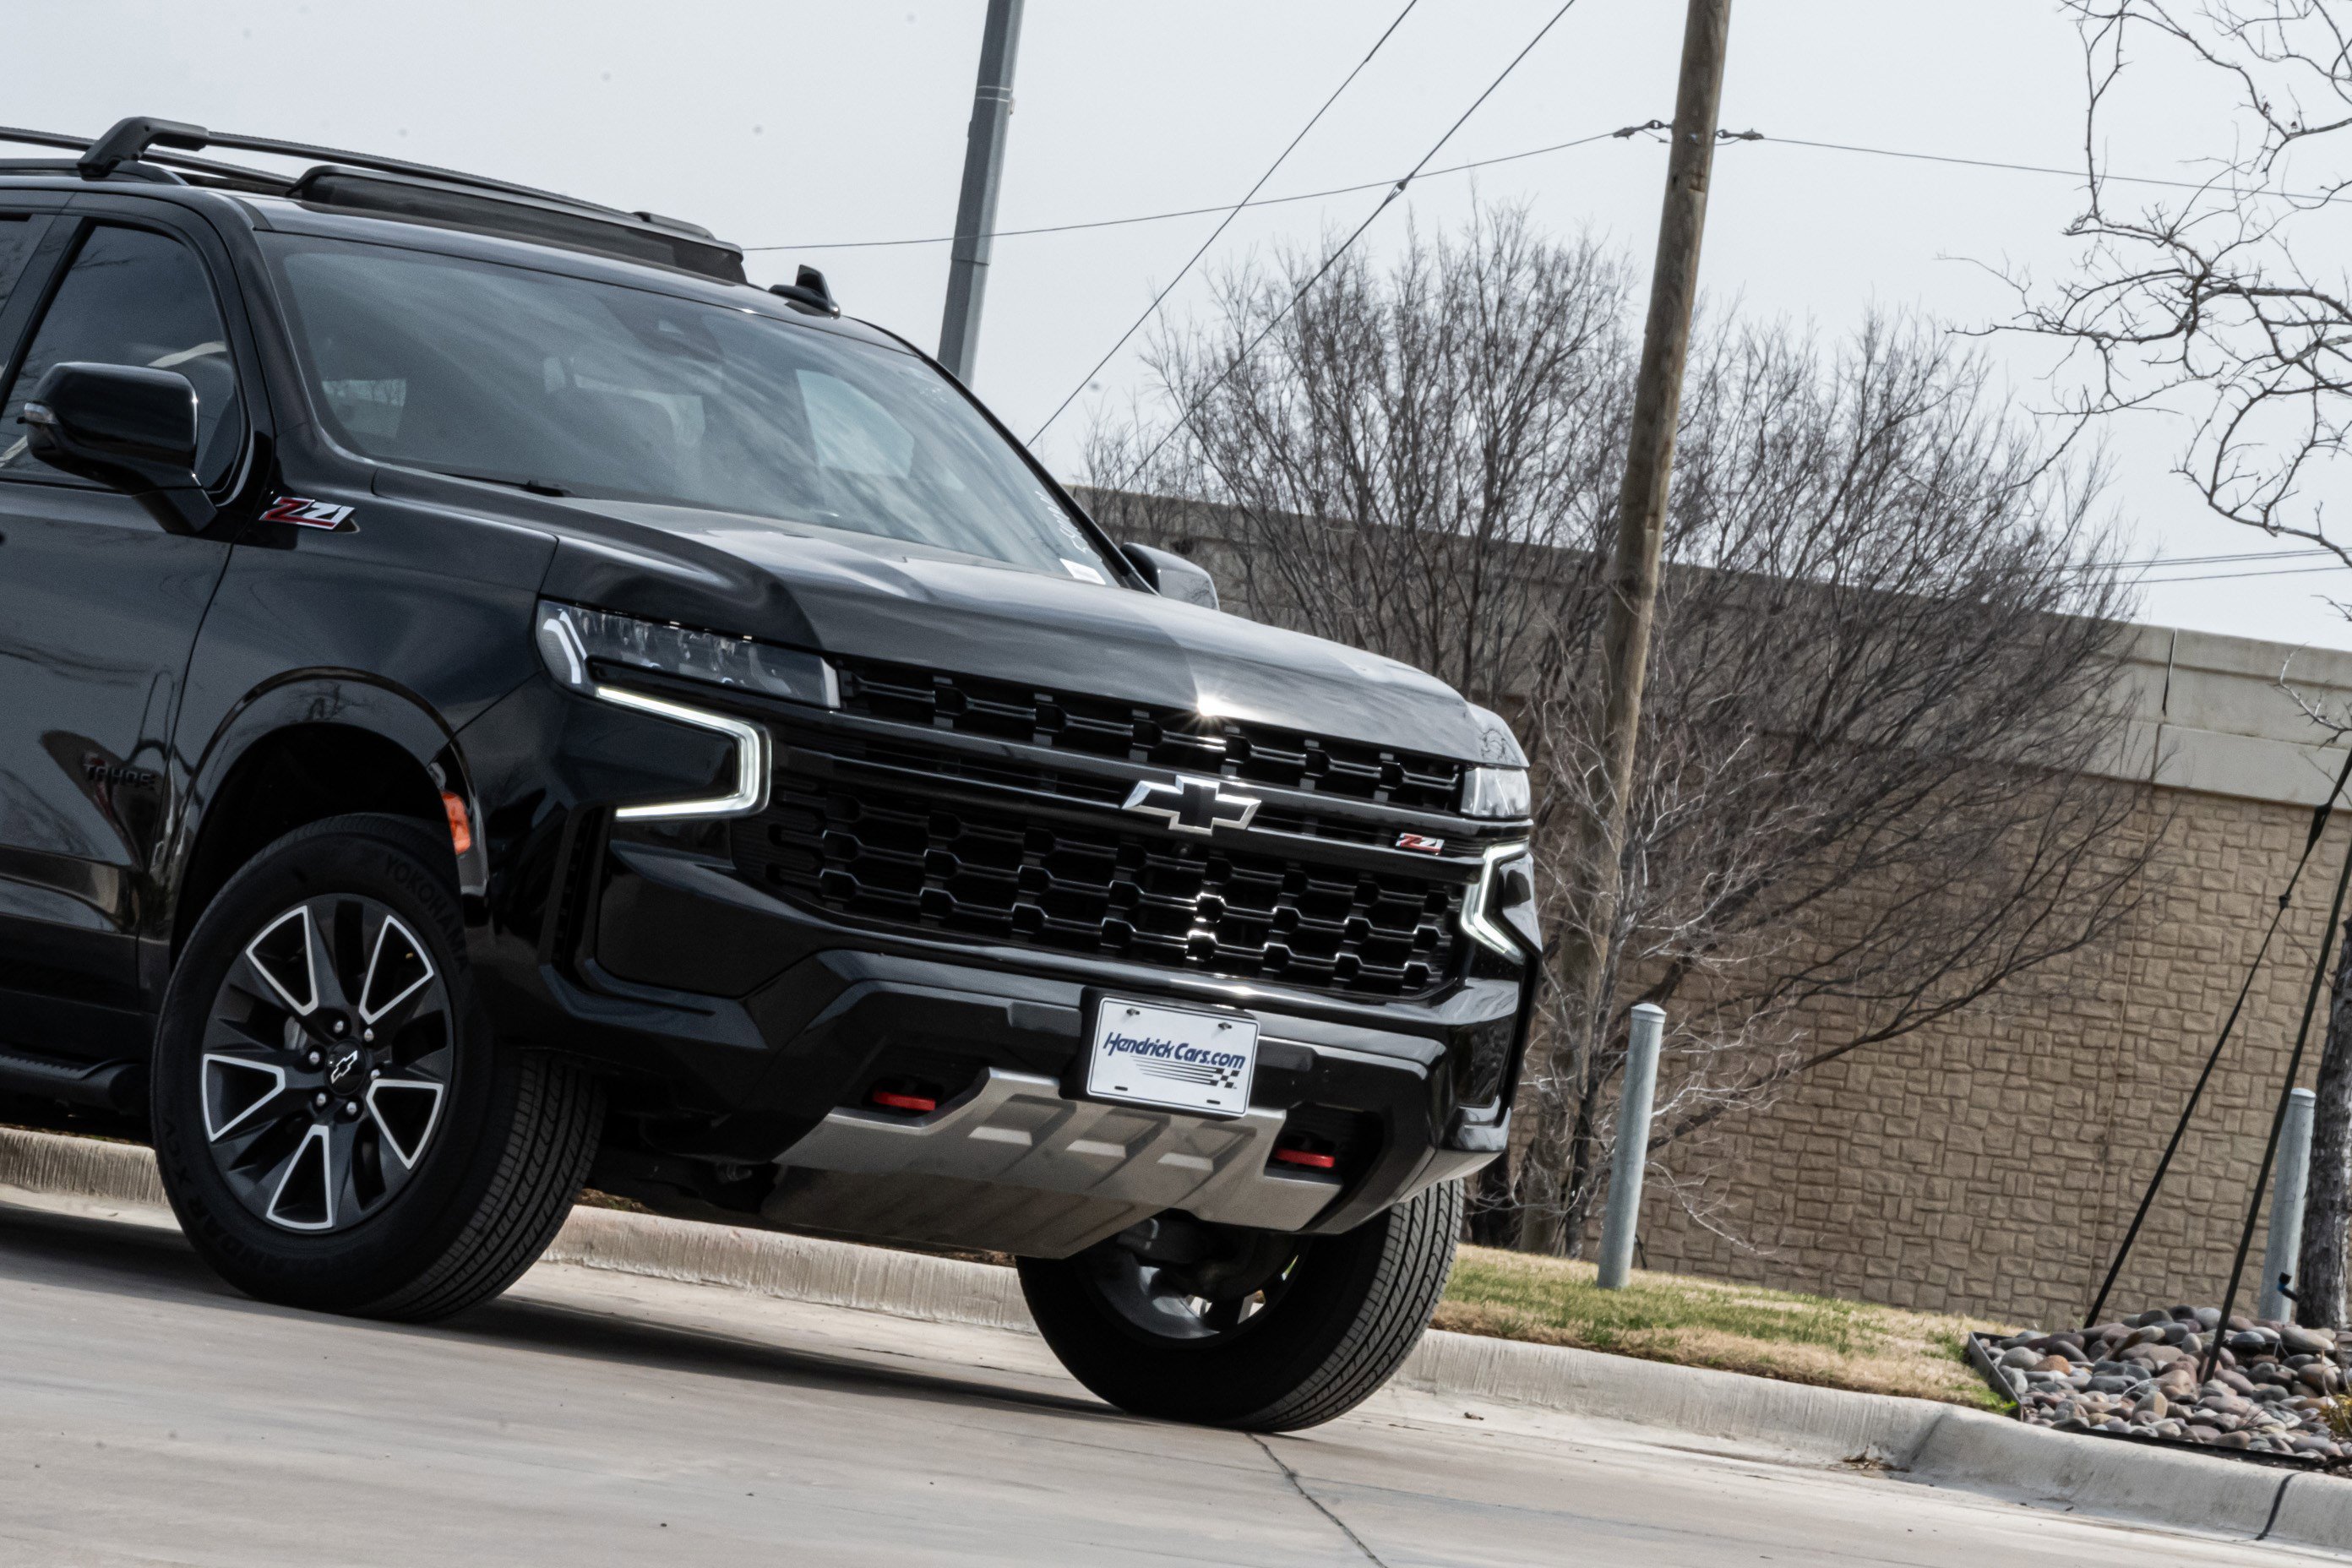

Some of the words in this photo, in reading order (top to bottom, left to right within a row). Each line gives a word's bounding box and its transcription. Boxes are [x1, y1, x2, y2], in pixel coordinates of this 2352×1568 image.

[259, 496, 355, 530] Z71
[1395, 832, 1445, 853] Z71
[384, 853, 469, 974] YOKOHAMA
[1102, 1032, 1246, 1070] HendrickCars.com
